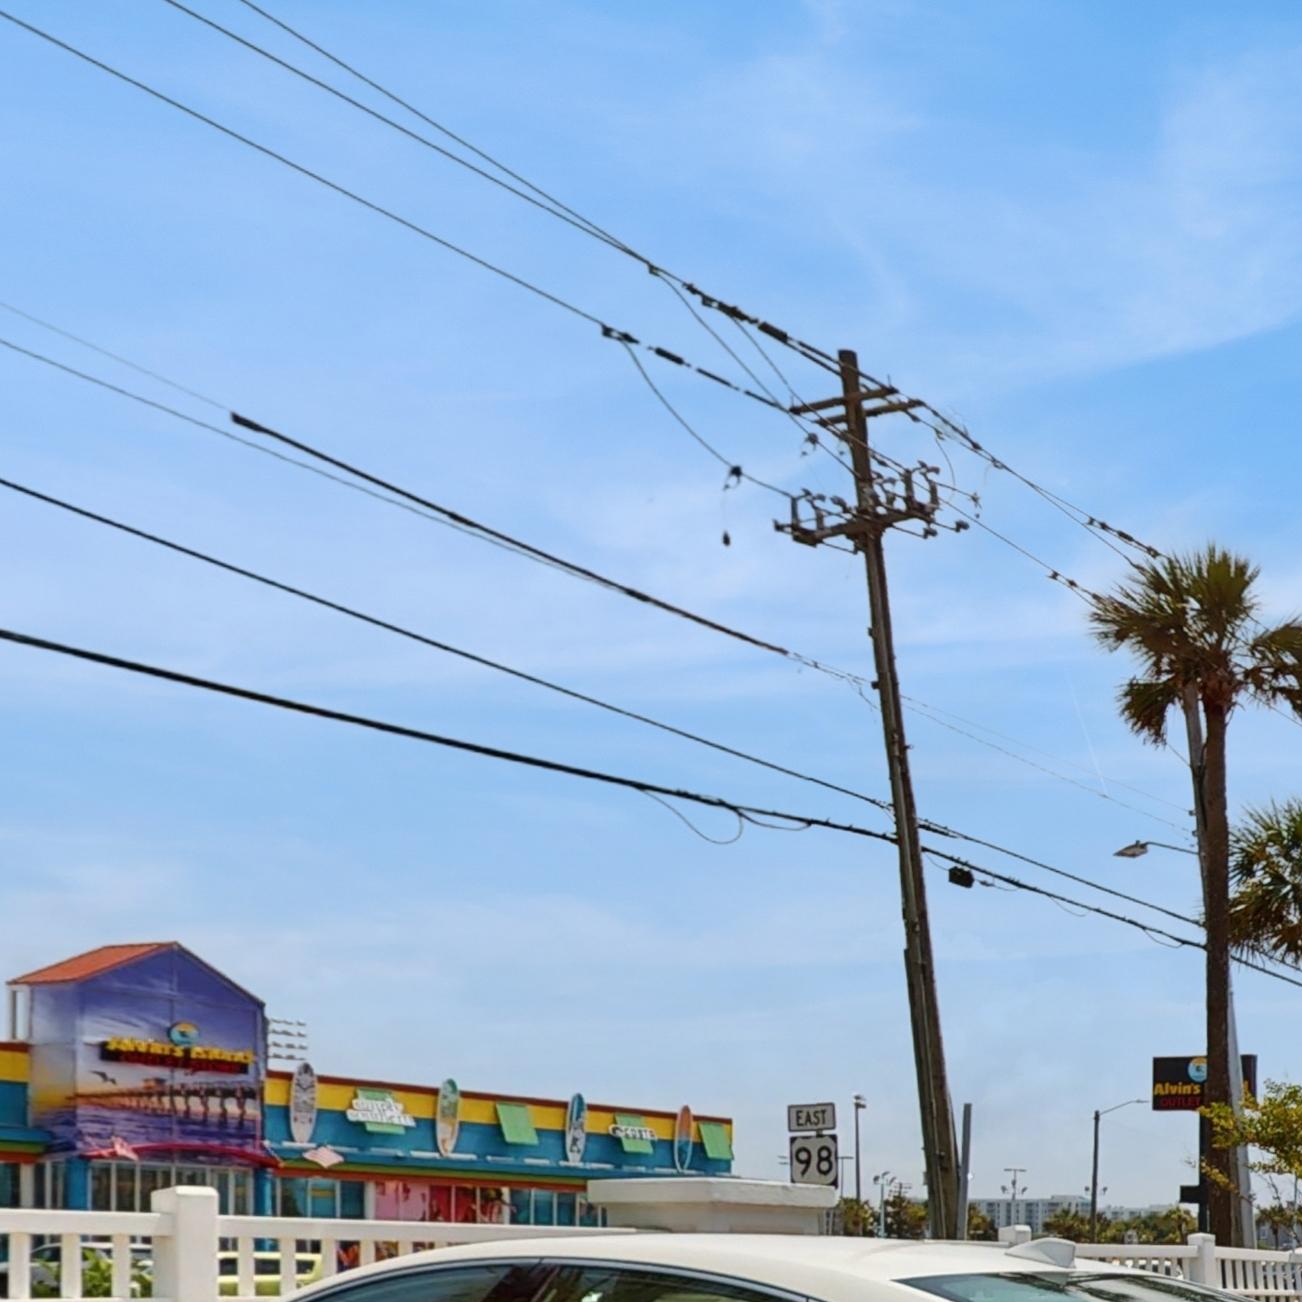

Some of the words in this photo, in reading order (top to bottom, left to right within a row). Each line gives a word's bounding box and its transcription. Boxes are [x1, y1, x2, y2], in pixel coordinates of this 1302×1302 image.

[1153, 1081, 1201, 1095] Alvin's
[795, 1108, 827, 1127] EAST
[795, 1145, 833, 1177] 98
